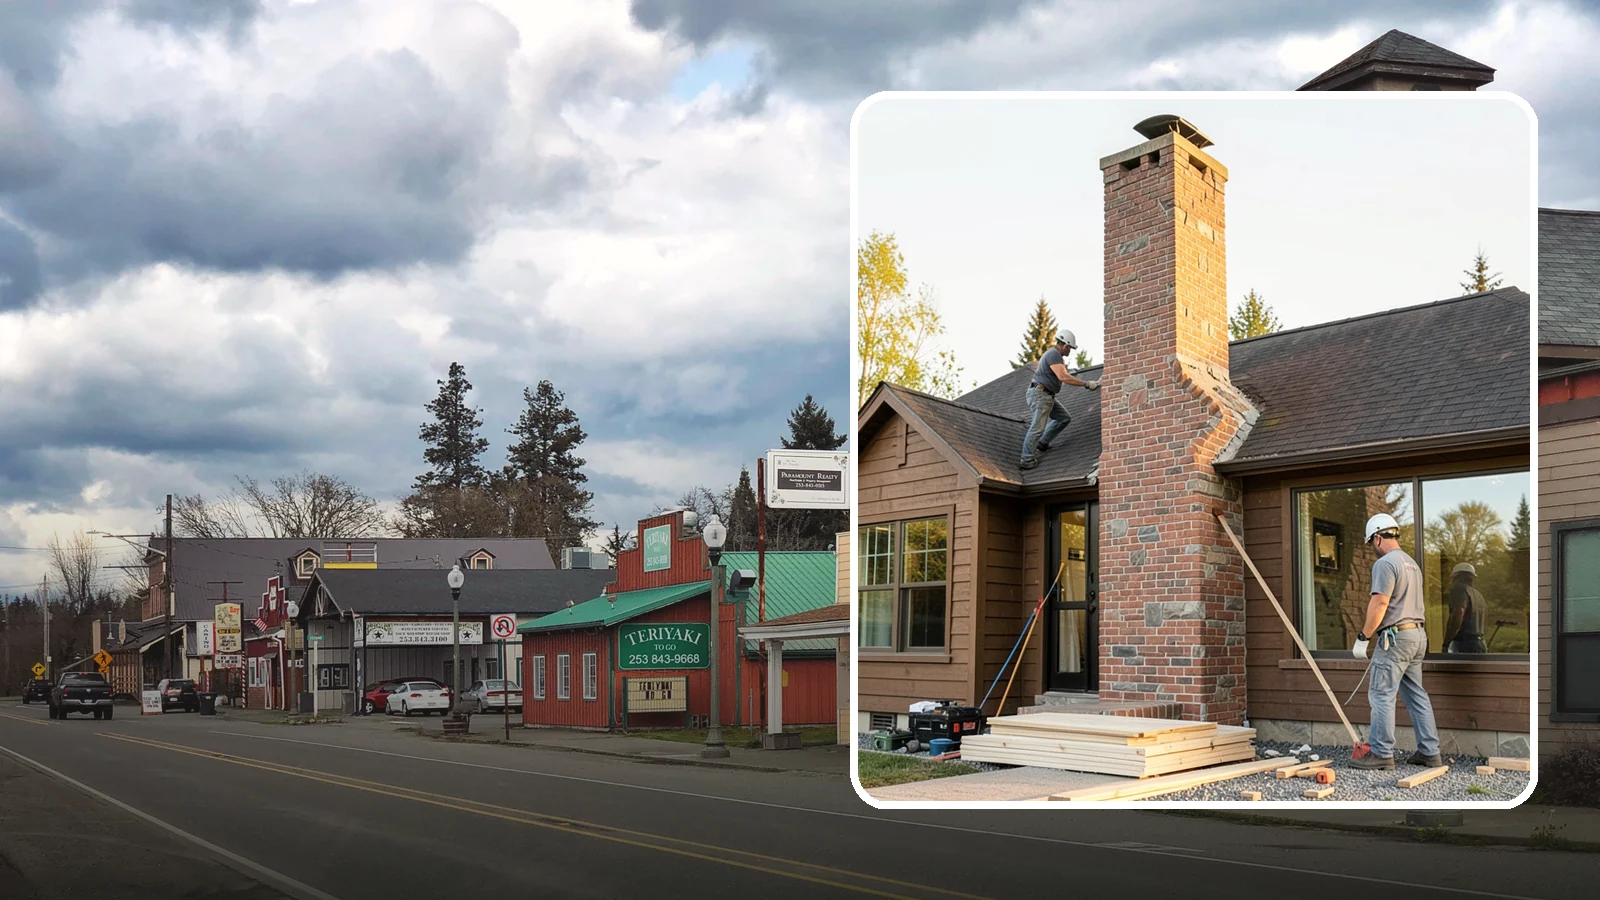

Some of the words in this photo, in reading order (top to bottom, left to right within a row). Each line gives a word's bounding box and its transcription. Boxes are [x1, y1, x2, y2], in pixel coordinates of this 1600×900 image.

[781, 471, 815, 479] PARAMOUNT
[817, 472, 839, 480] REALTY
[624, 627, 702, 646] TERIYAKI
[628, 654, 649, 665] 253
[651, 653, 700, 664] 843-9668
[639, 681, 672, 691] TERIYAKI
